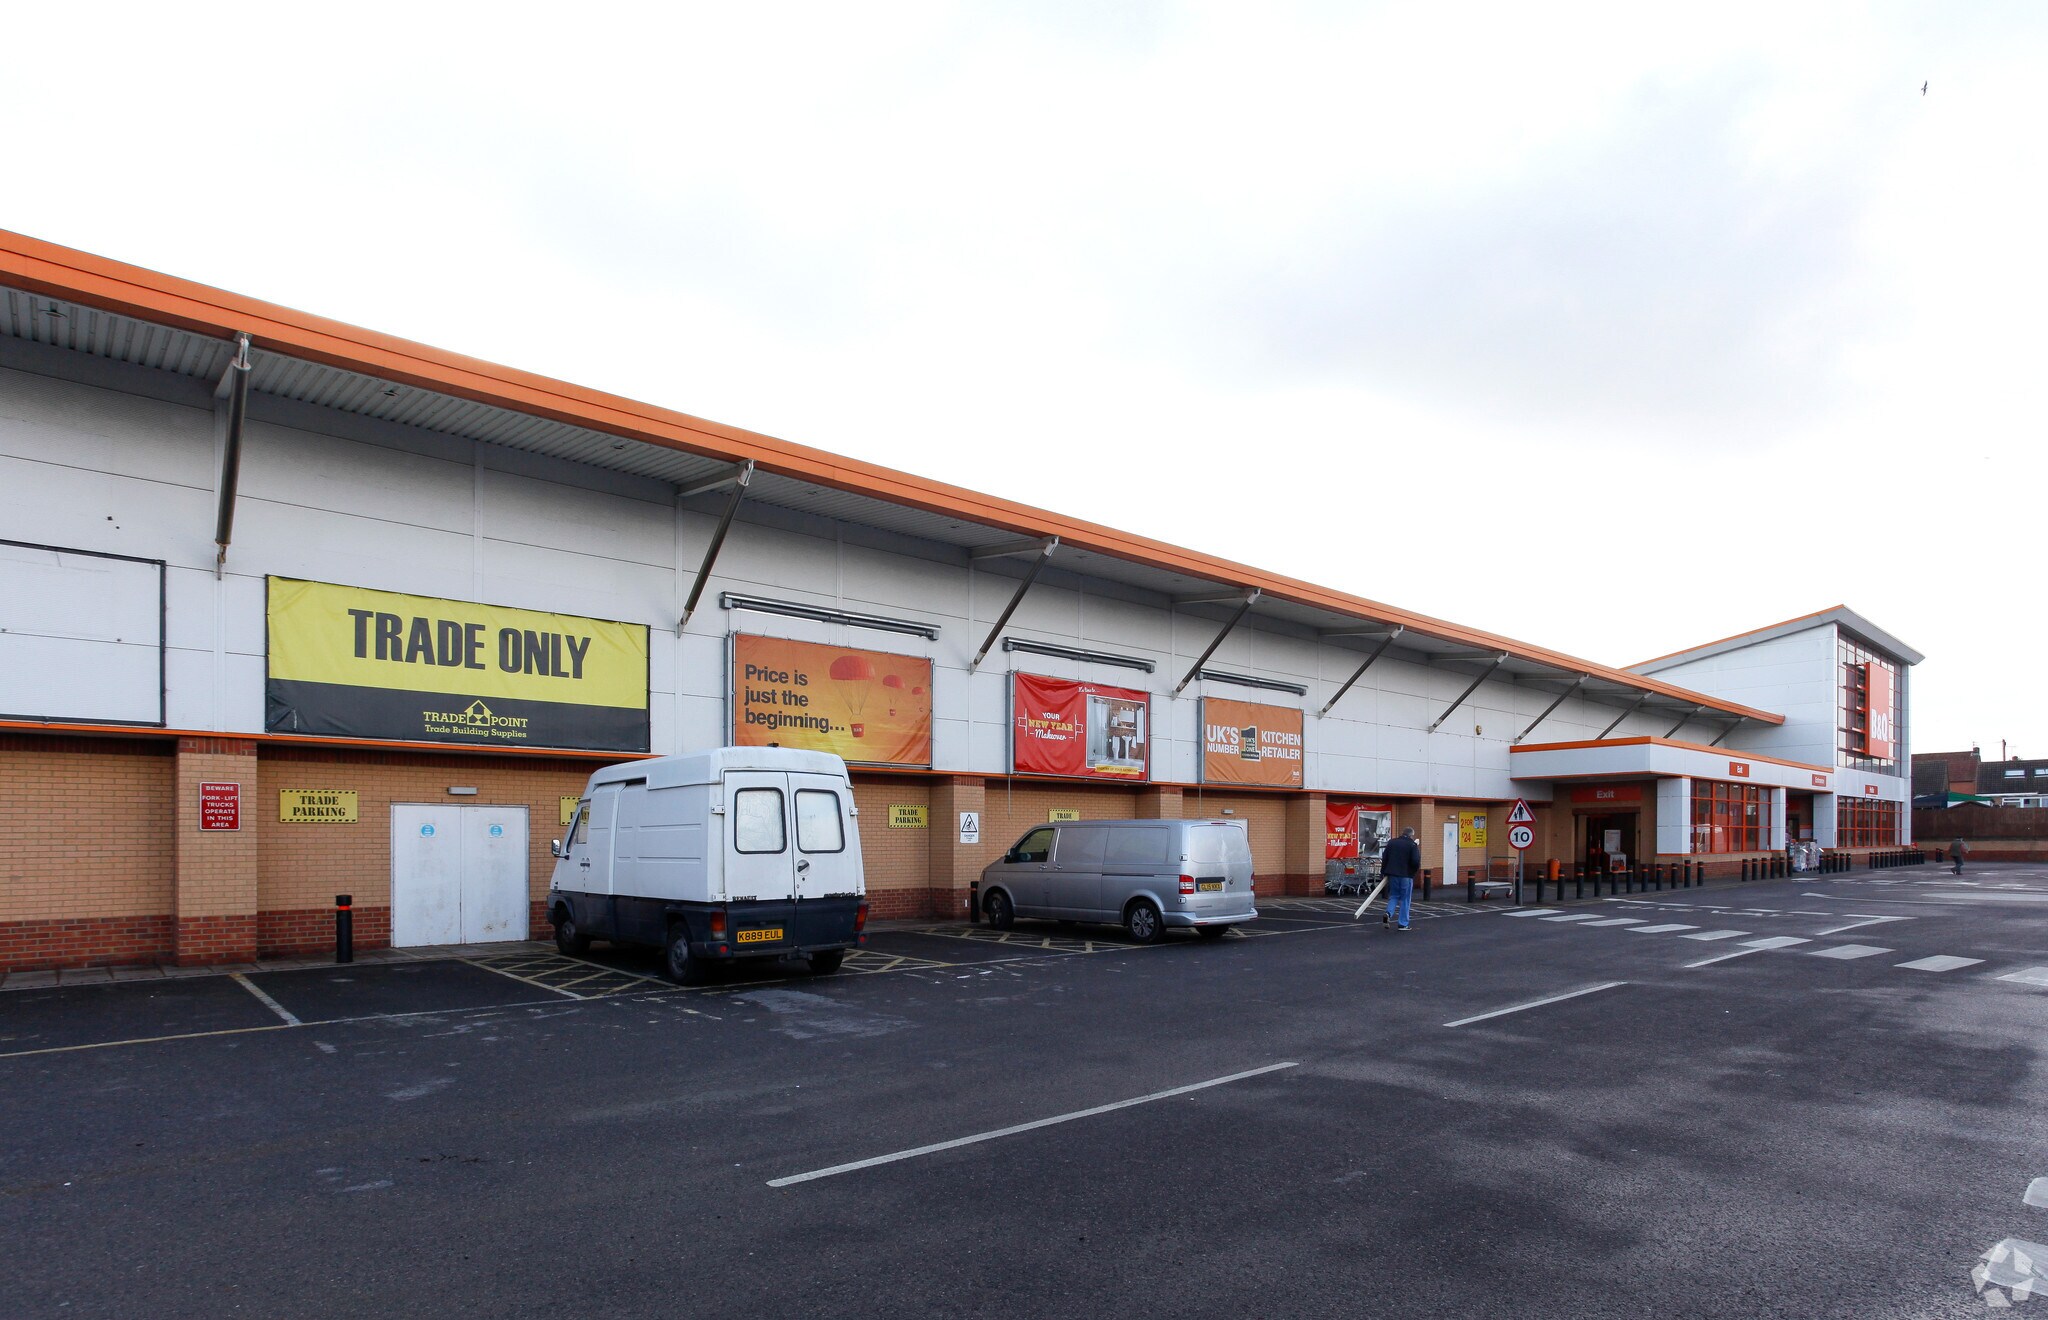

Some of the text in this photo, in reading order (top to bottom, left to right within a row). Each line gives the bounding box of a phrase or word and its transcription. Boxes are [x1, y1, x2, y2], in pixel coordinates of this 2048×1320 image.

[348, 608, 592, 680] TRADE ONLY
[744, 663, 808, 686] Price is
[744, 686, 809, 707] just the
[423, 711, 528, 728] TRADE POINT
[745, 707, 845, 733] beginning...
[1042, 712, 1060, 720] YOUR
[424, 724, 527, 738] Trade Building Supplies
[1028, 719, 1073, 731] NEW YEAR
[1871, 708, 1888, 742] B&Q
[1034, 728, 1067, 741] Makeover
[1206, 724, 1240, 745] UK'S
[1261, 730, 1301, 746] KITCHEN
[1207, 742, 1240, 755] NUMBER
[1261, 746, 1301, 760] RETAILER
[300, 795, 339, 806] TRADE
[1596, 790, 1615, 799] Exit
[292, 806, 346, 817] PARKING
[898, 808, 918, 816] TRADE
[895, 816, 922, 824] PARKING
[1465, 818, 1473, 826] FOR
[1513, 831, 1530, 842] 10
[738, 930, 782, 942] K889 EUL
